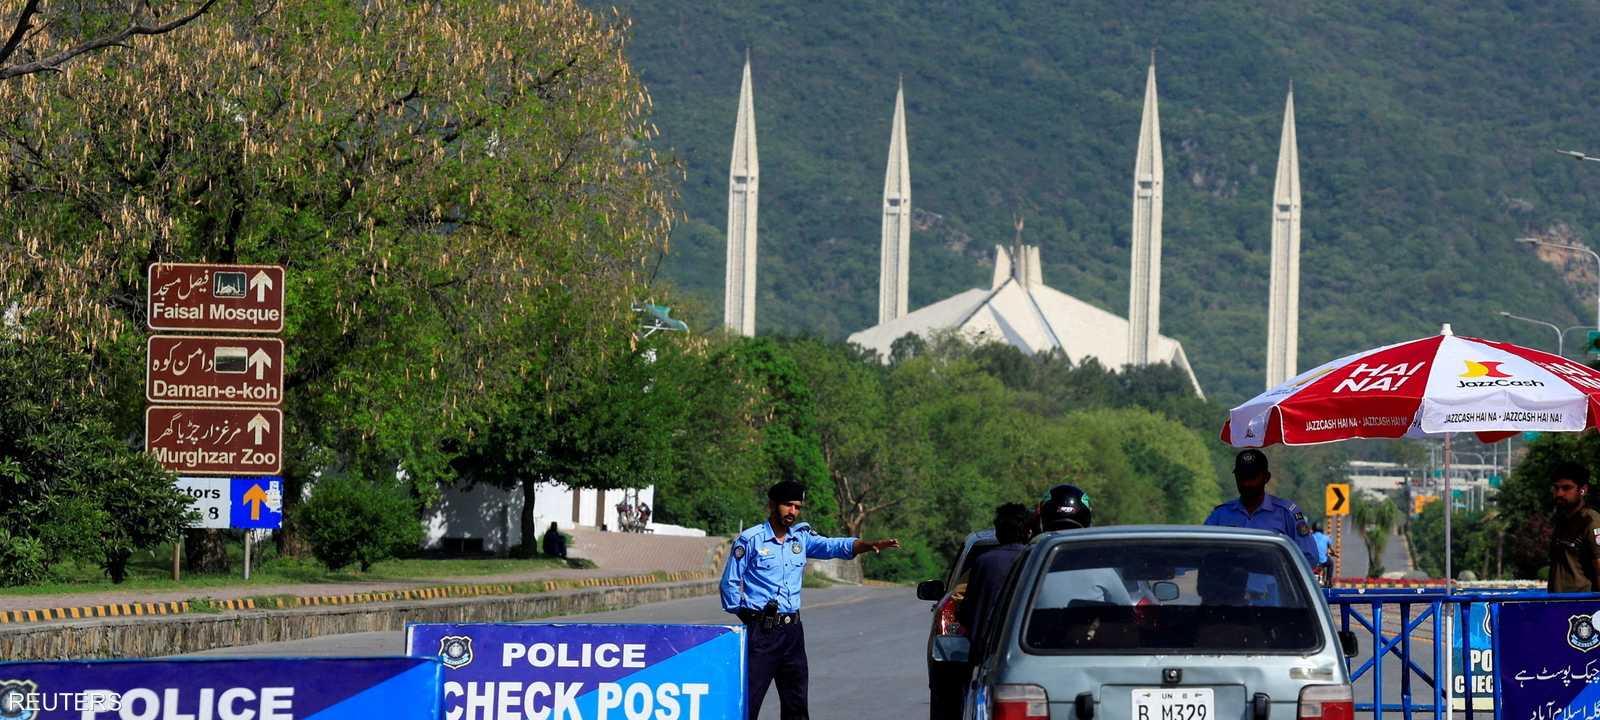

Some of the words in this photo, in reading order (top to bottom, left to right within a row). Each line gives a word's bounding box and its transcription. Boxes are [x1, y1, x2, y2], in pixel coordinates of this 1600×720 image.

[153, 278, 181, 301] مسجد
[178, 270, 209, 300] فیصل
[153, 303, 204, 320] Faisal
[209, 304, 280, 325] Mosque
[172, 347, 213, 376] دامن
[1349, 361, 1426, 377] HAI
[153, 380, 278, 400] Daman-e-koh
[1332, 376, 1409, 393] NA!
[1456, 379, 1545, 388] JazzCash
[1306, 418, 1337, 432] JAZZCASH
[1337, 418, 1349, 428] HAI
[1349, 416, 1359, 427] NA
[1362, 415, 1391, 427] JAZZCASH
[1443, 412, 1474, 424] JAZZCASH
[1475, 412, 1487, 422] HAI
[1488, 412, 1497, 422] NA
[1503, 411, 1536, 423] JAZZCASH
[1537, 412, 1549, 423] HAI
[1550, 413, 1562, 423] NA!
[200, 419, 242, 445] مرغزار
[152, 447, 237, 467] Murghzar
[240, 448, 276, 465] Zoo
[208, 506, 219, 520] 8
[502, 643, 646, 668] POLICE
[80, 687, 295, 720] POLICE
[445, 681, 584, 720] CHECK
[597, 683, 709, 720] POST
[1161, 704, 1207, 720] M329
